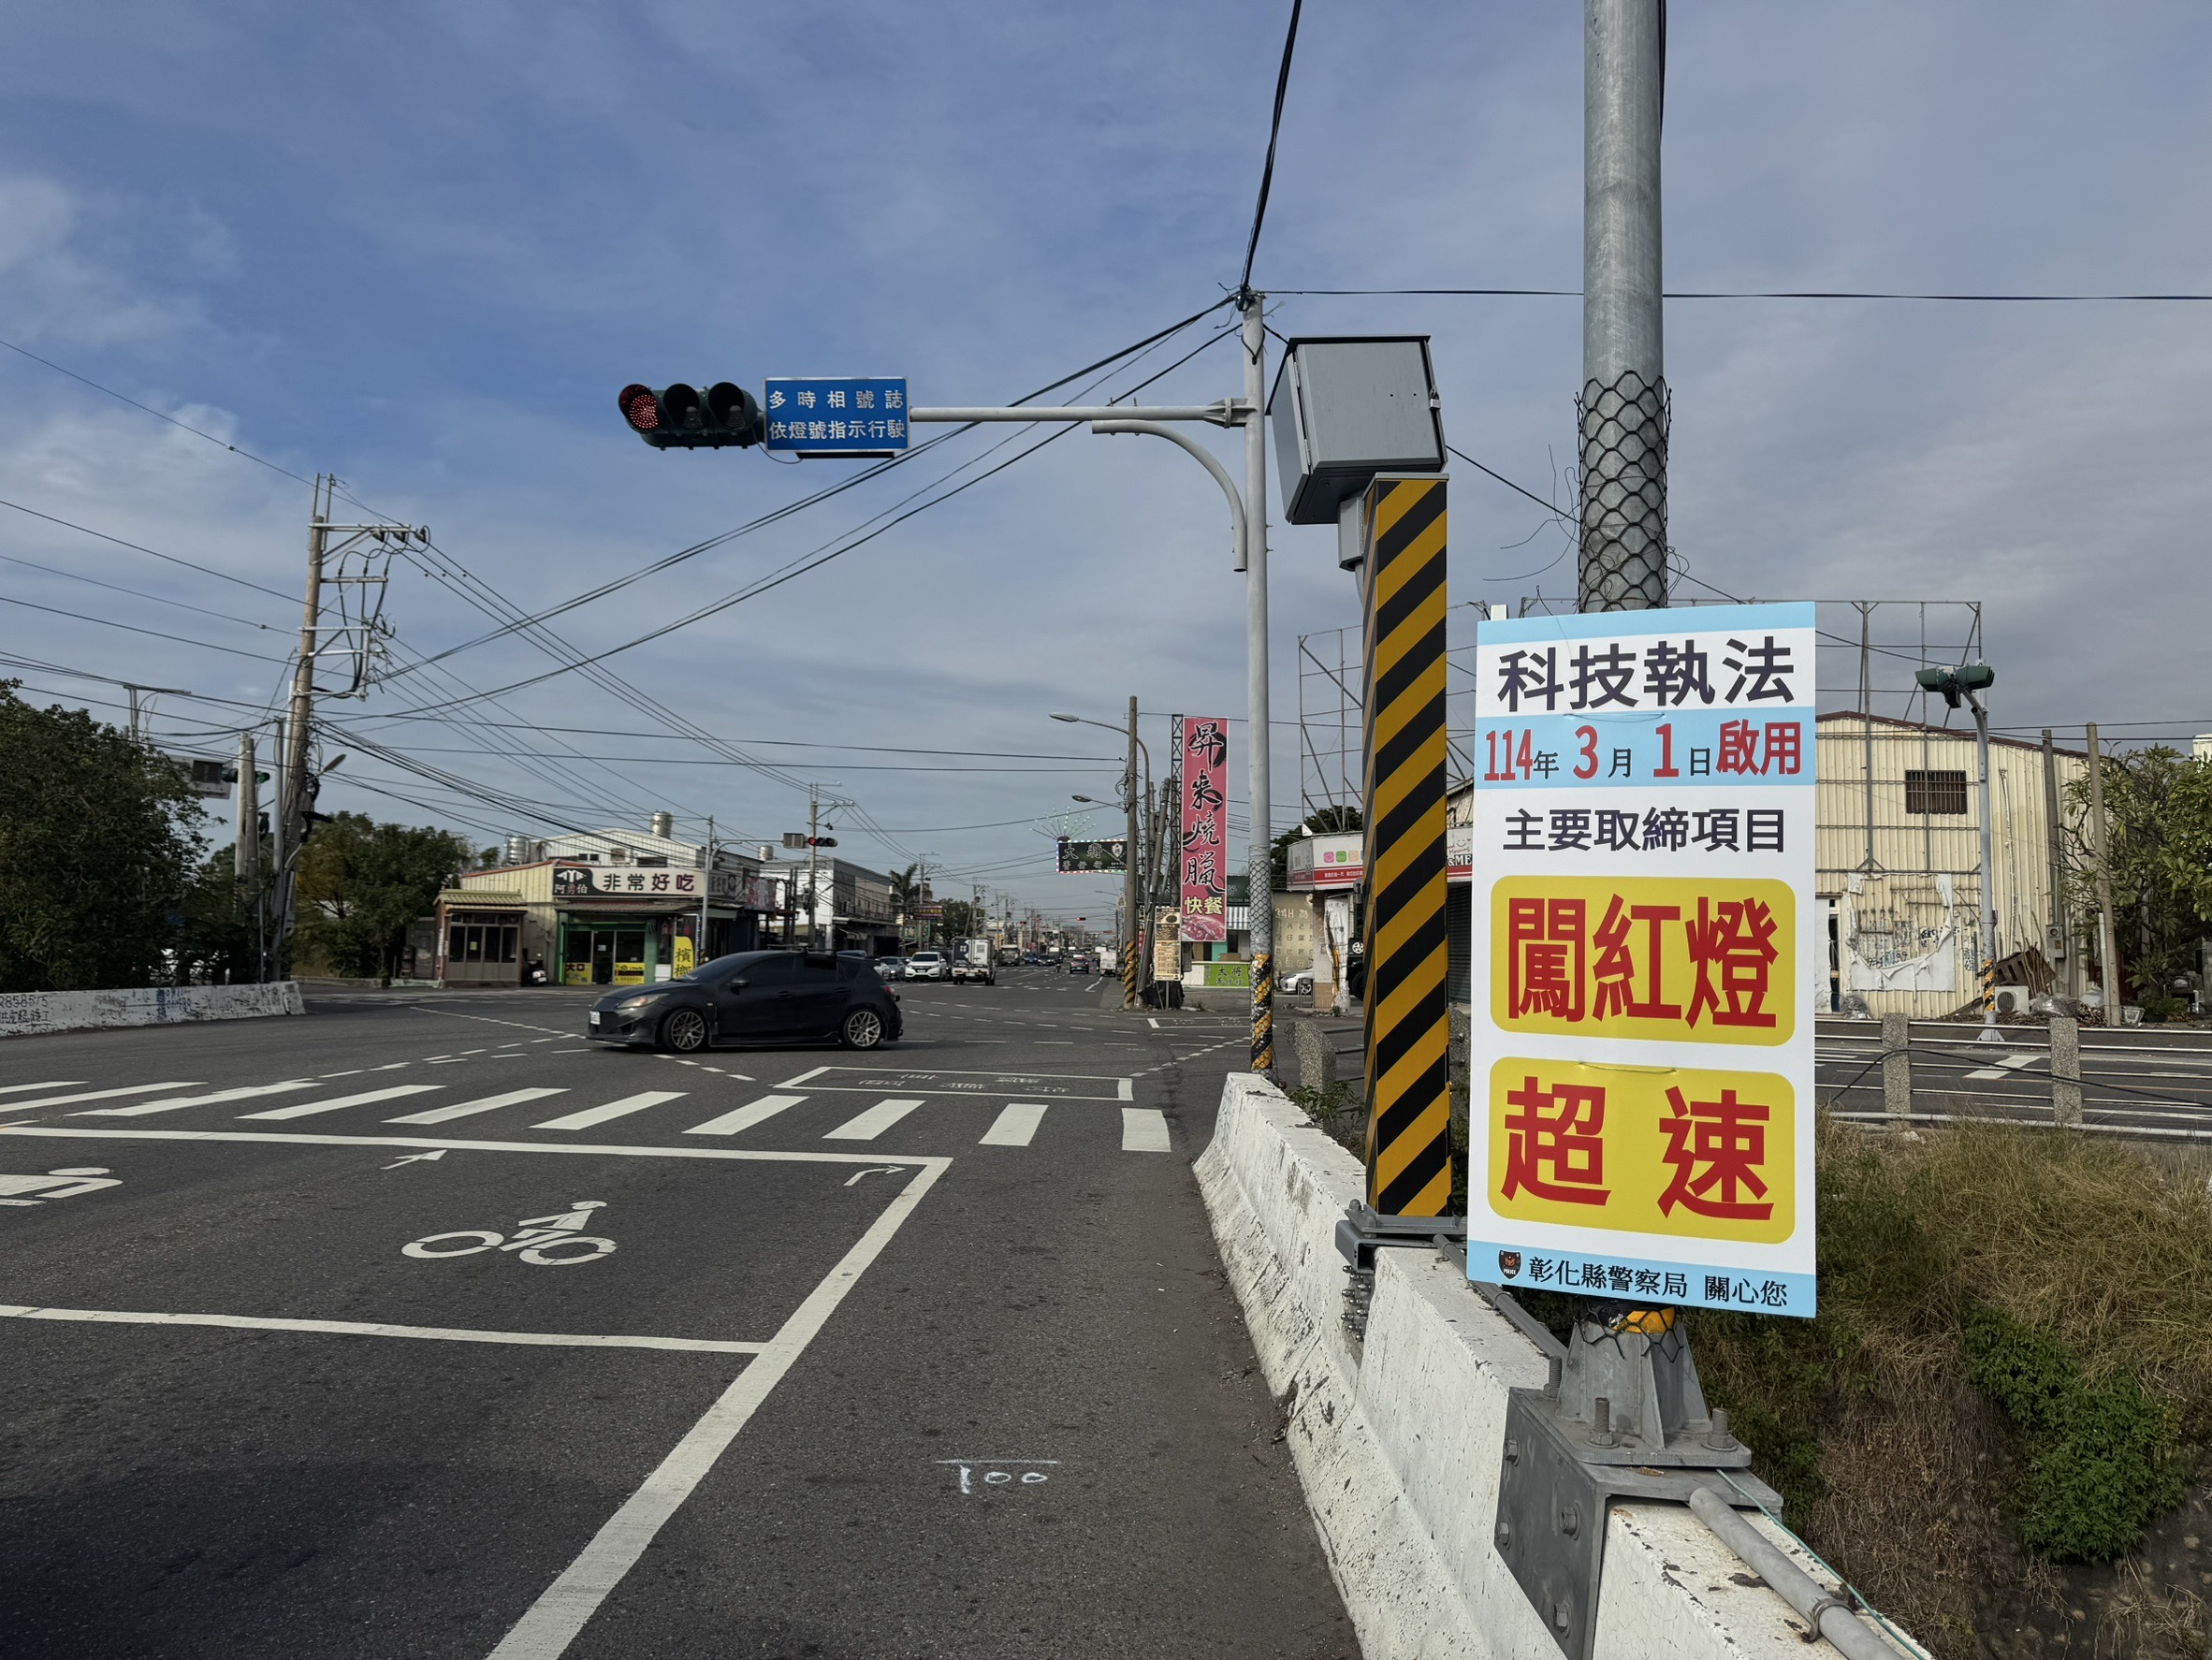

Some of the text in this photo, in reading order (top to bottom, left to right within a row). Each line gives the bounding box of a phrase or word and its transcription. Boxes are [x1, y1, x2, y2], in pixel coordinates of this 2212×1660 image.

[768, 389, 904, 409] 多時相號誌
[768, 420, 905, 440] 依燈號指示行駛
[1497, 635, 1795, 712] 科技執法
[1503, 807, 1784, 853] 主要取締項目
[603, 873, 695, 892] 非常好吃
[1184, 896, 1223, 915] 快餐
[1508, 894, 1778, 1028] 闖紅燈
[1501, 1076, 1774, 1220] 超速
[1528, 1256, 1788, 1307] 彰化縣警察局 關心您
